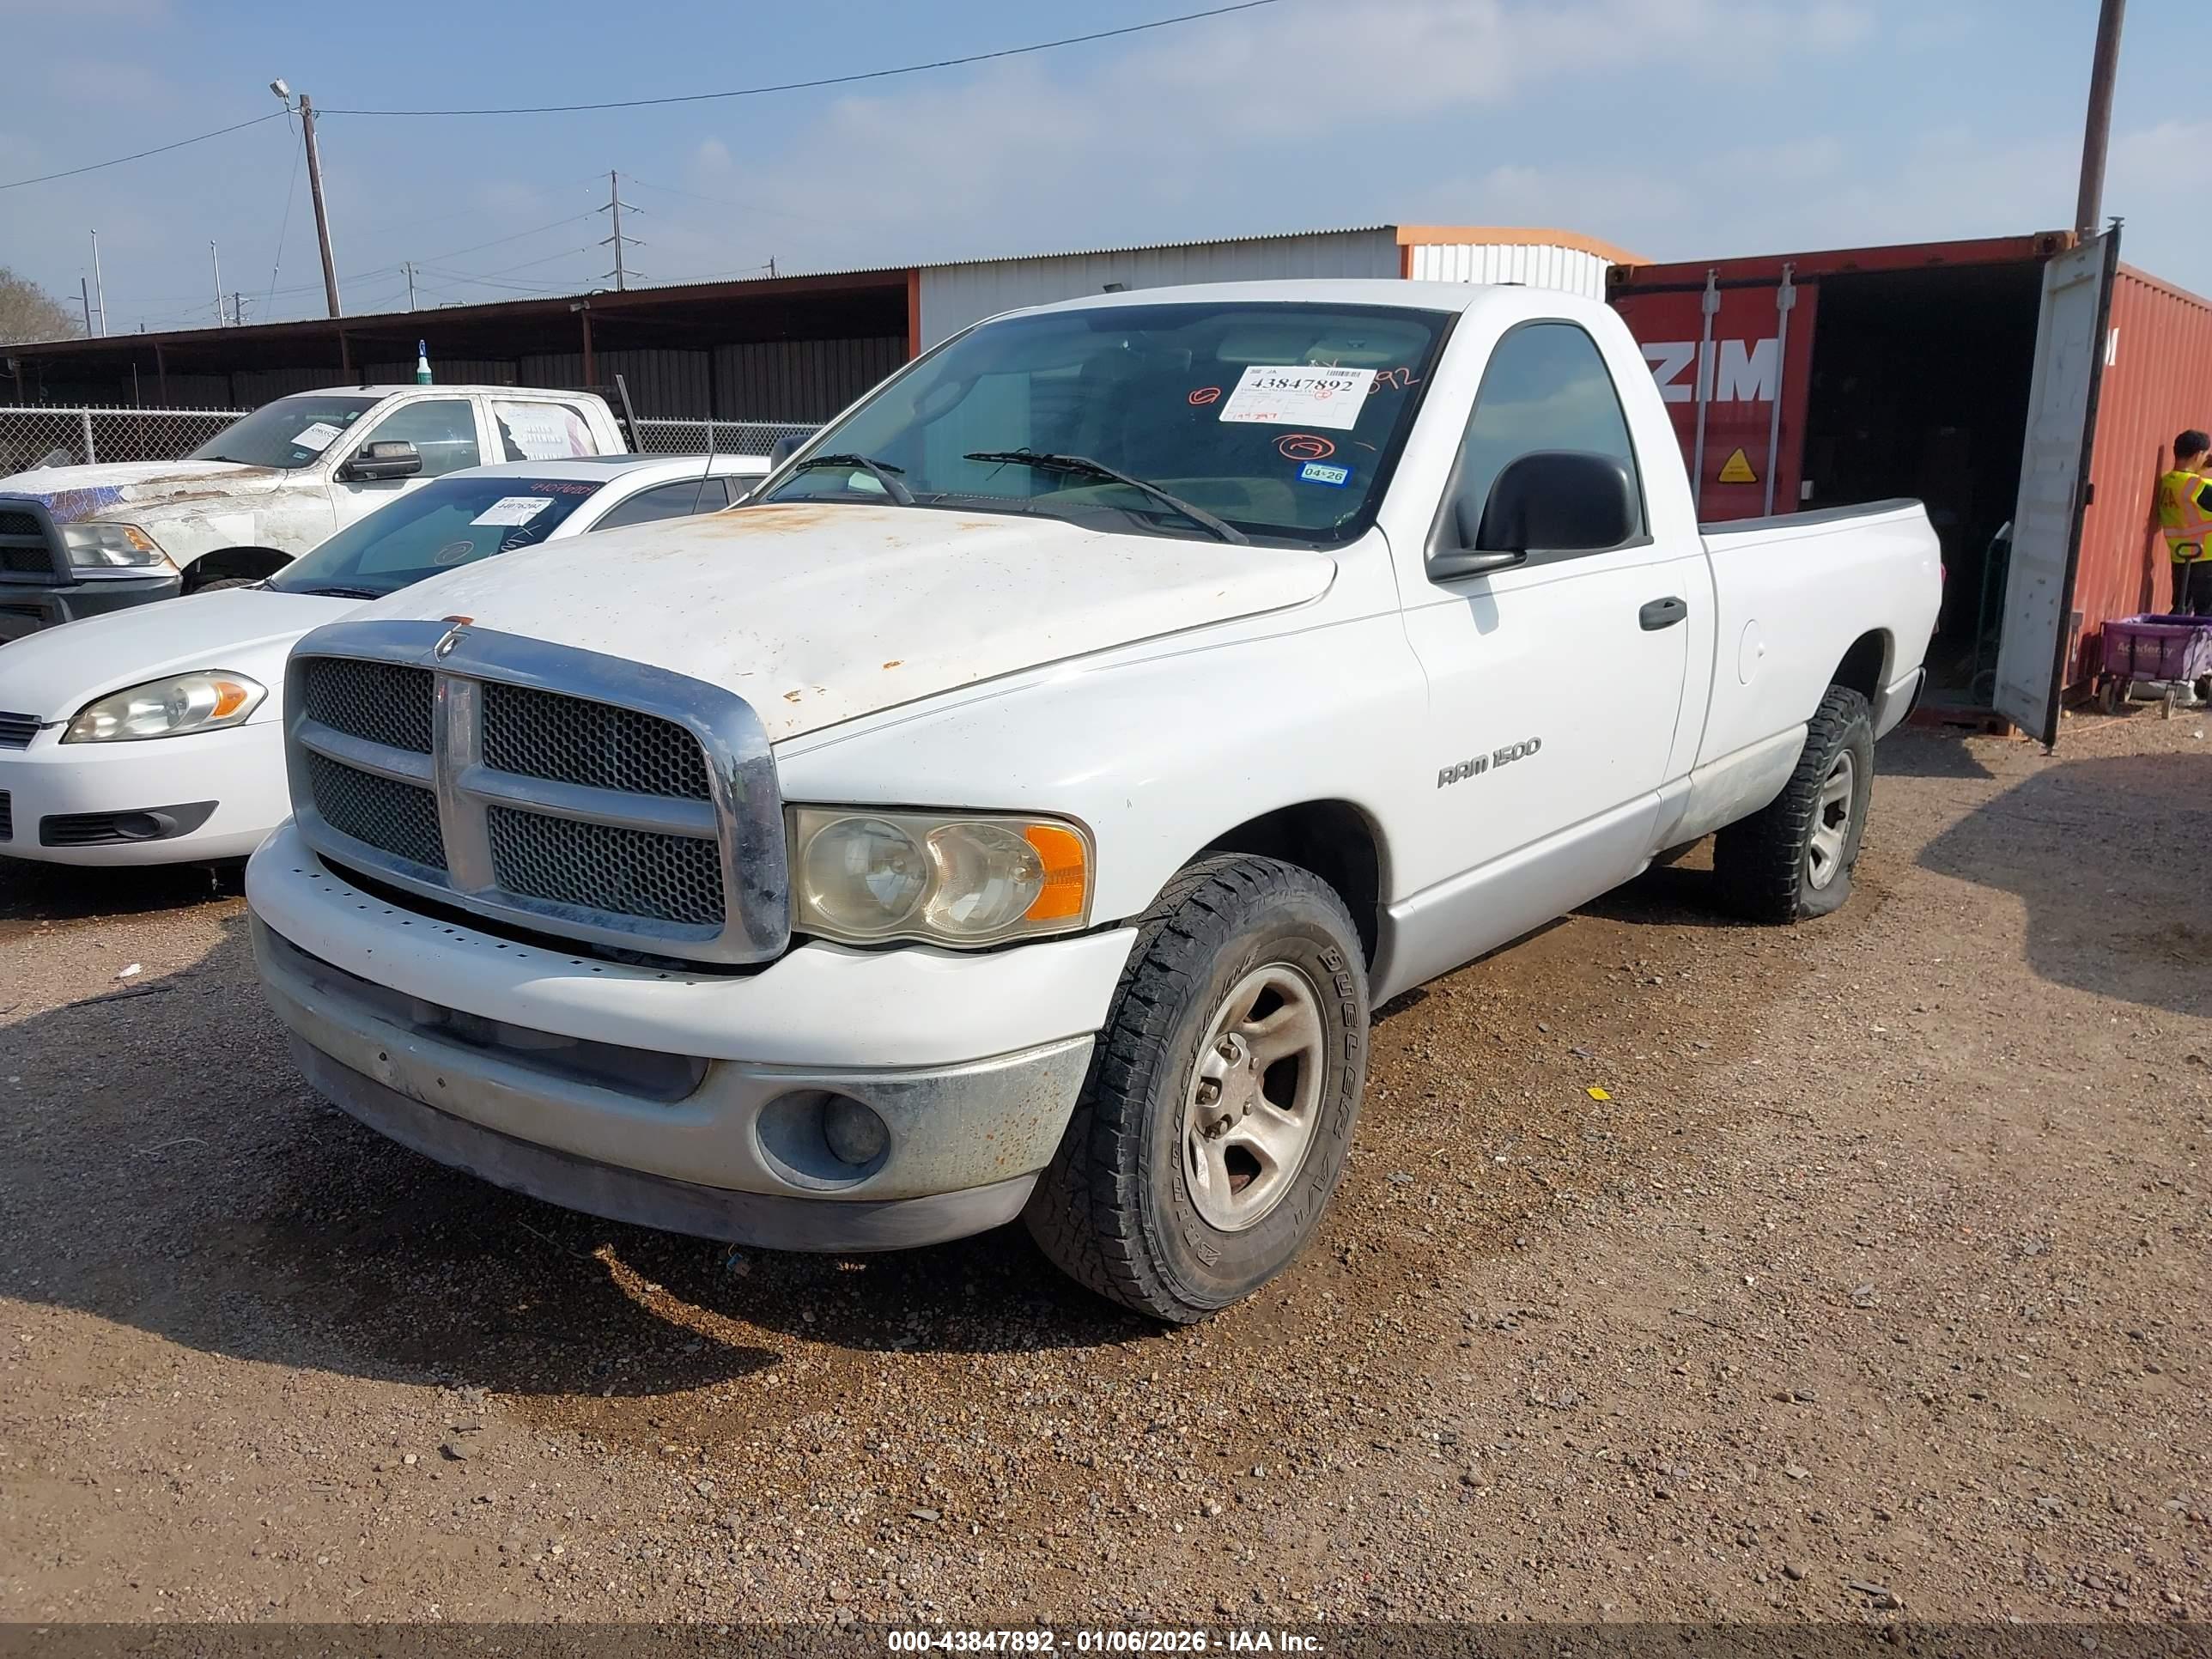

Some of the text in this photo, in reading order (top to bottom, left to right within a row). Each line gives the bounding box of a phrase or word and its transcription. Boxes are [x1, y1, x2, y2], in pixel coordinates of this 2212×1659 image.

[1251, 377, 1353, 392] 43847892
[1641, 338, 1779, 403] ZIM
[1437, 737, 1542, 789] RAM 1500
[1317, 945, 1358, 1140] DUELER
